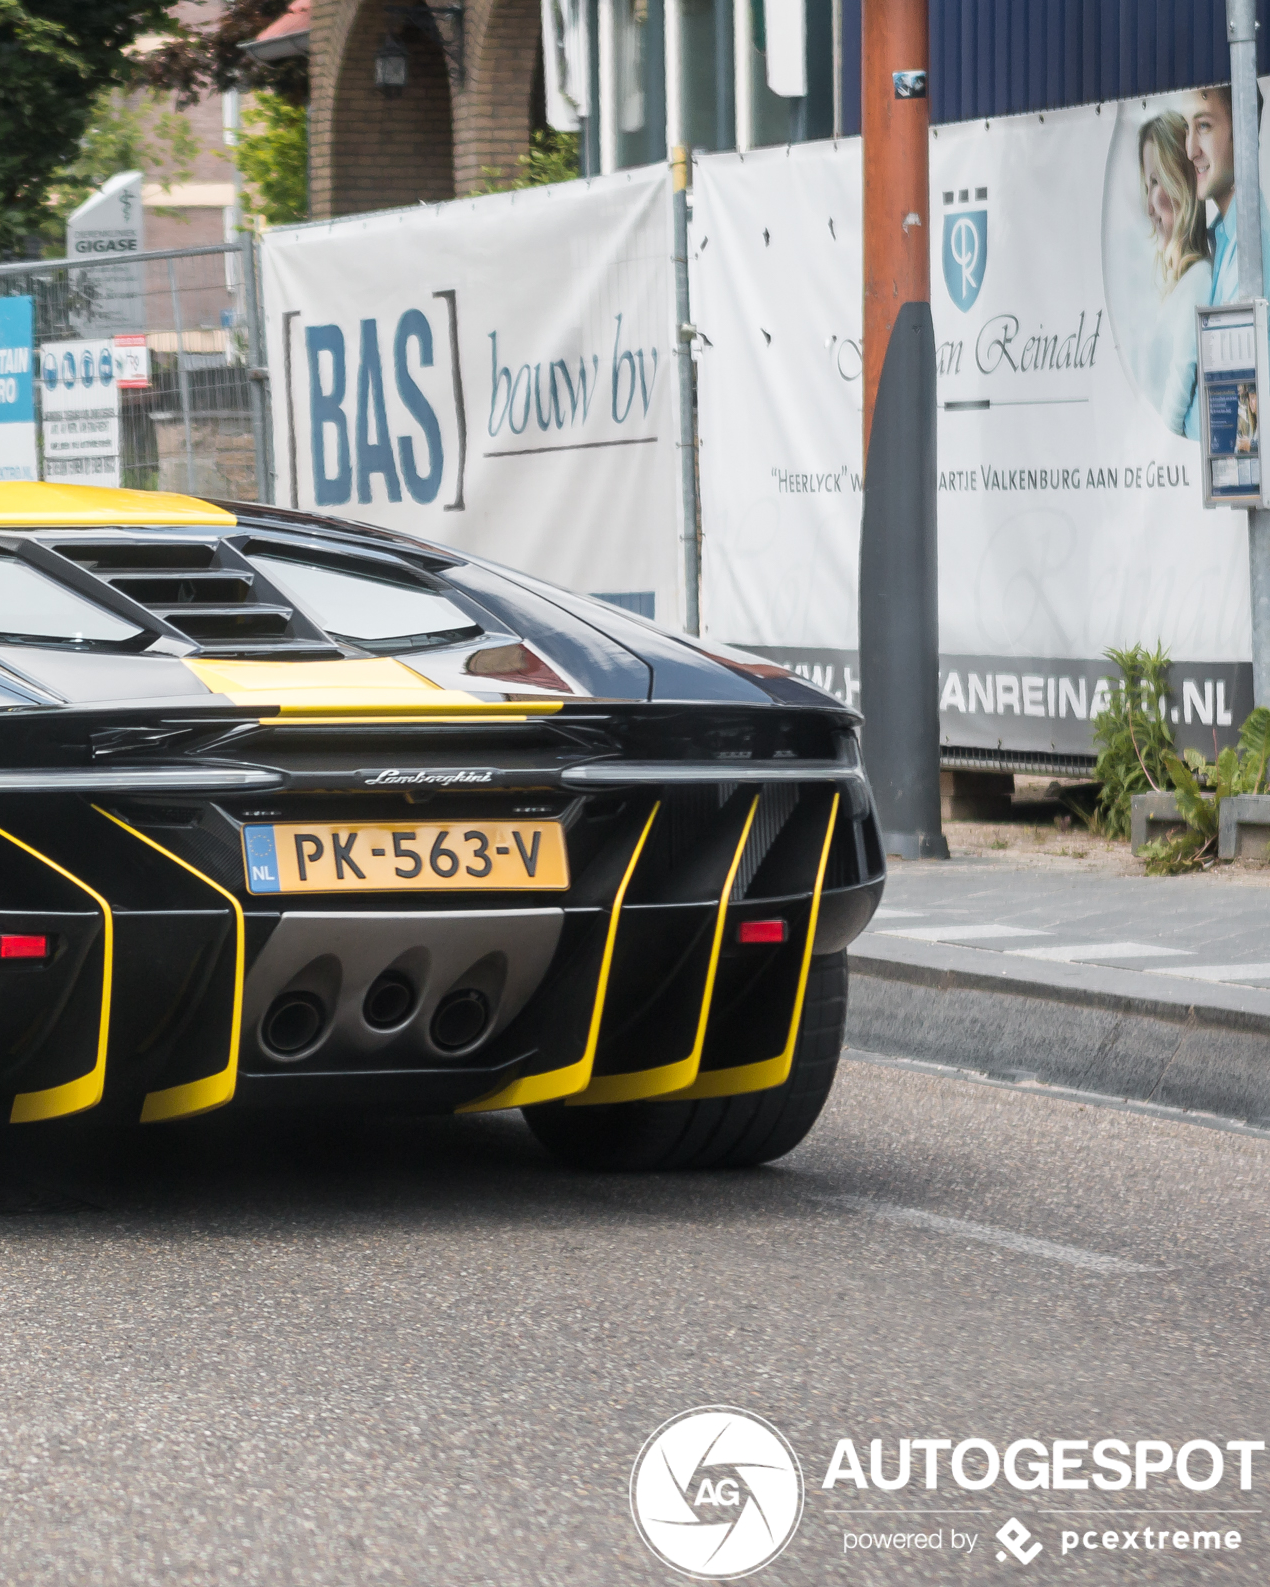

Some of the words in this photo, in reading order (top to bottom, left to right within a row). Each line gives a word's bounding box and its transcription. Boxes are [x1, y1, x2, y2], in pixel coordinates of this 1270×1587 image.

[75, 239, 137, 253] GIGASE
[934, 340, 963, 377] an
[975, 309, 1103, 375] Reinald
[487, 331, 599, 437] bouw
[611, 313, 658, 425] bv
[938, 470, 978, 491] ARTJE
[980, 464, 1081, 491] VALKENBURG
[1085, 467, 1119, 490] AAN
[1124, 467, 1143, 489] DE
[1146, 460, 1191, 489] GEUL
[365, 770, 492, 786] Lamborghini
[252, 866, 275, 880] NL
[294, 831, 542, 881] PK-563-V
